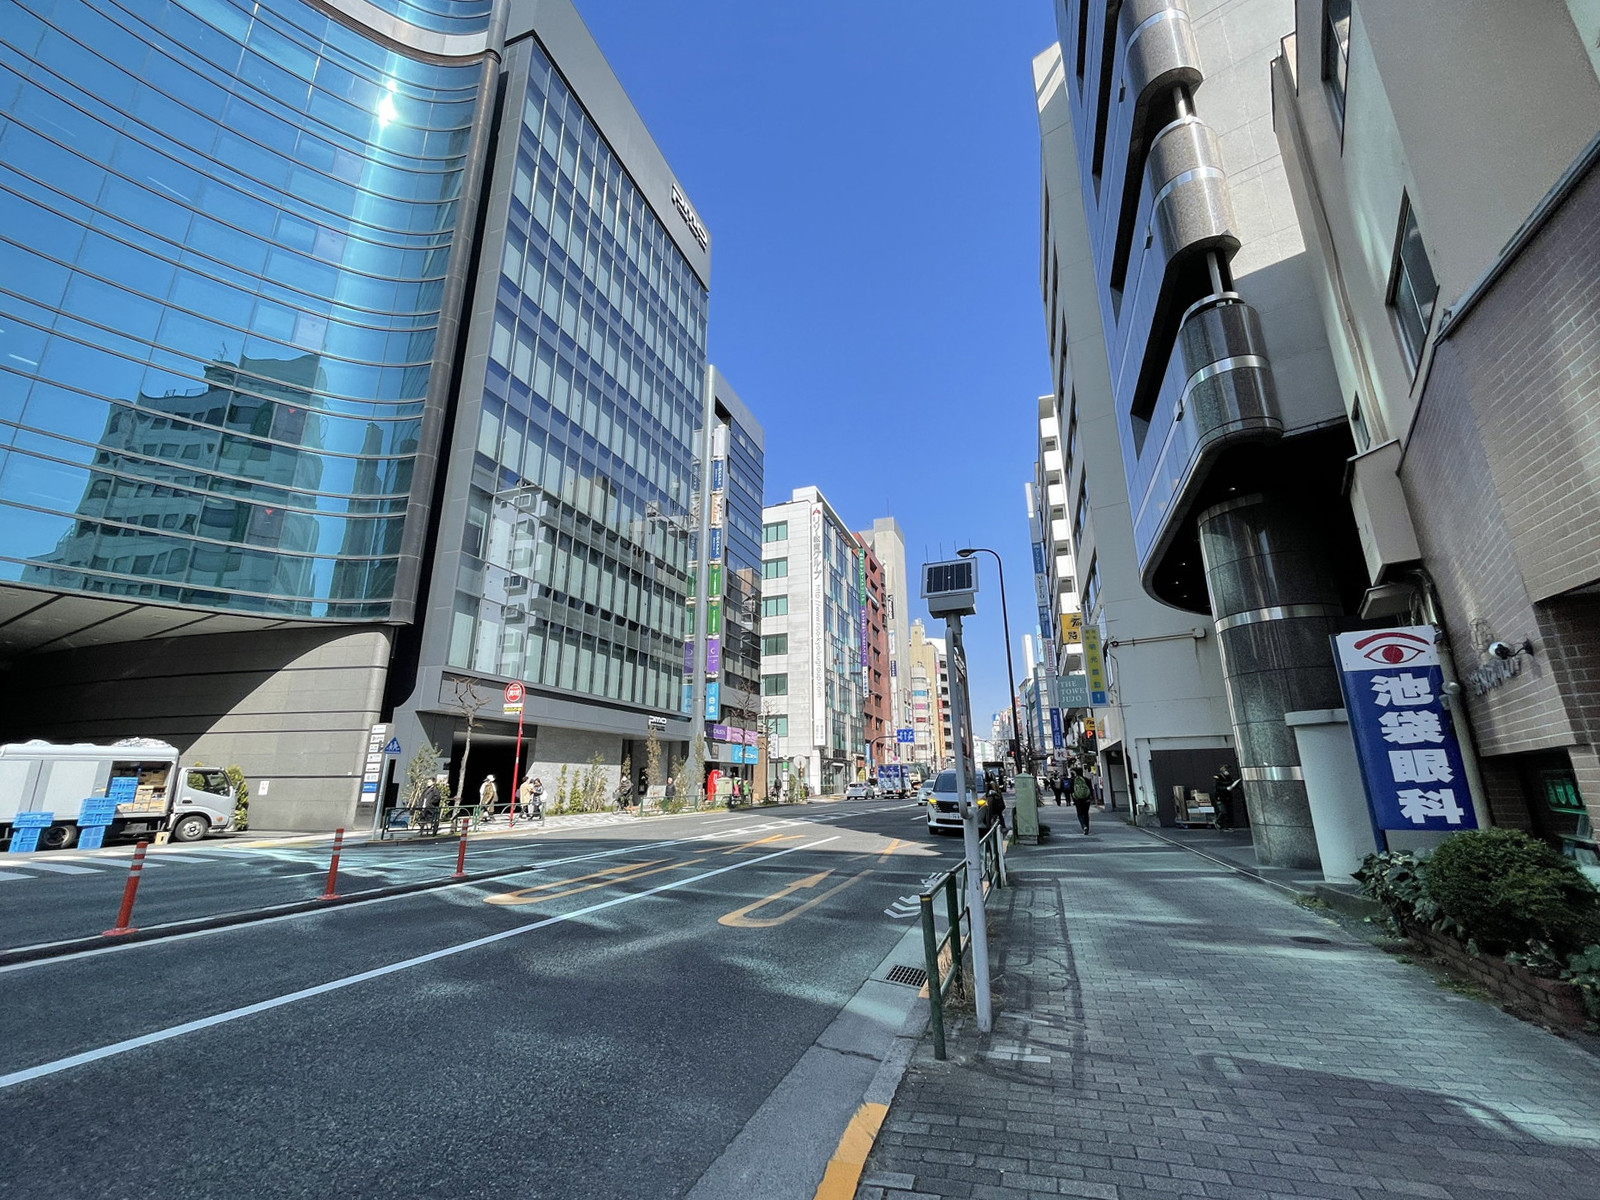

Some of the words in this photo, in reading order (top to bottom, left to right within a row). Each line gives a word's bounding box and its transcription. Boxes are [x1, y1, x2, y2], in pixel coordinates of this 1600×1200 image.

[1060, 680, 1077, 688] THE
[1061, 687, 1087, 695] TOWE
[648, 715, 667, 725] pmo
[1370, 672, 1464, 825] 池袋眼科
